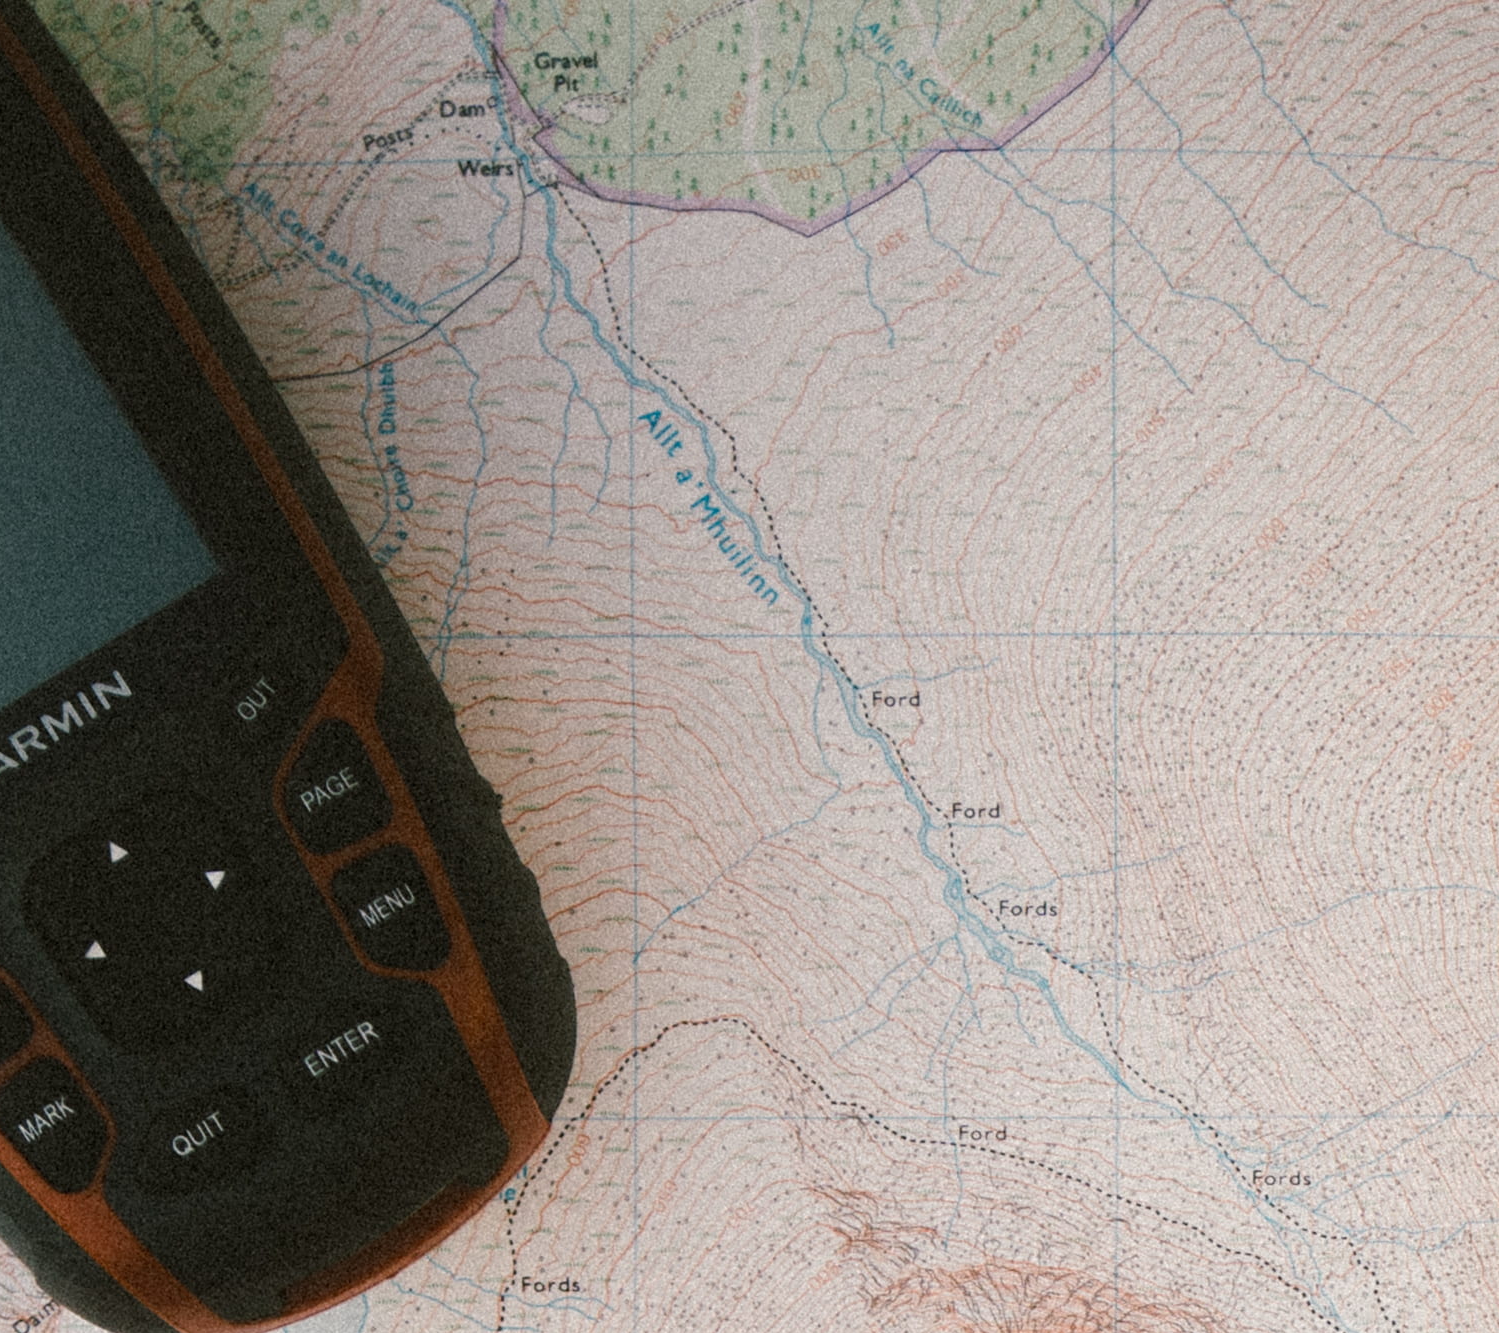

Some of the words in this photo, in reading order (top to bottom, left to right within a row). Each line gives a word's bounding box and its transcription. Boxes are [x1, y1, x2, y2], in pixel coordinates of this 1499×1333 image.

[534, 52, 599, 75] Gravel
[553, 73, 581, 94] Pit
[439, 98, 487, 120] Dam
[235, 677, 278, 725] OUT
[299, 766, 360, 816] PAGE
[359, 881, 418, 931] MENU
[303, 1019, 382, 1078] ENTER
[18, 1095, 76, 1145] MARK
[171, 1111, 229, 1159] QUIT
